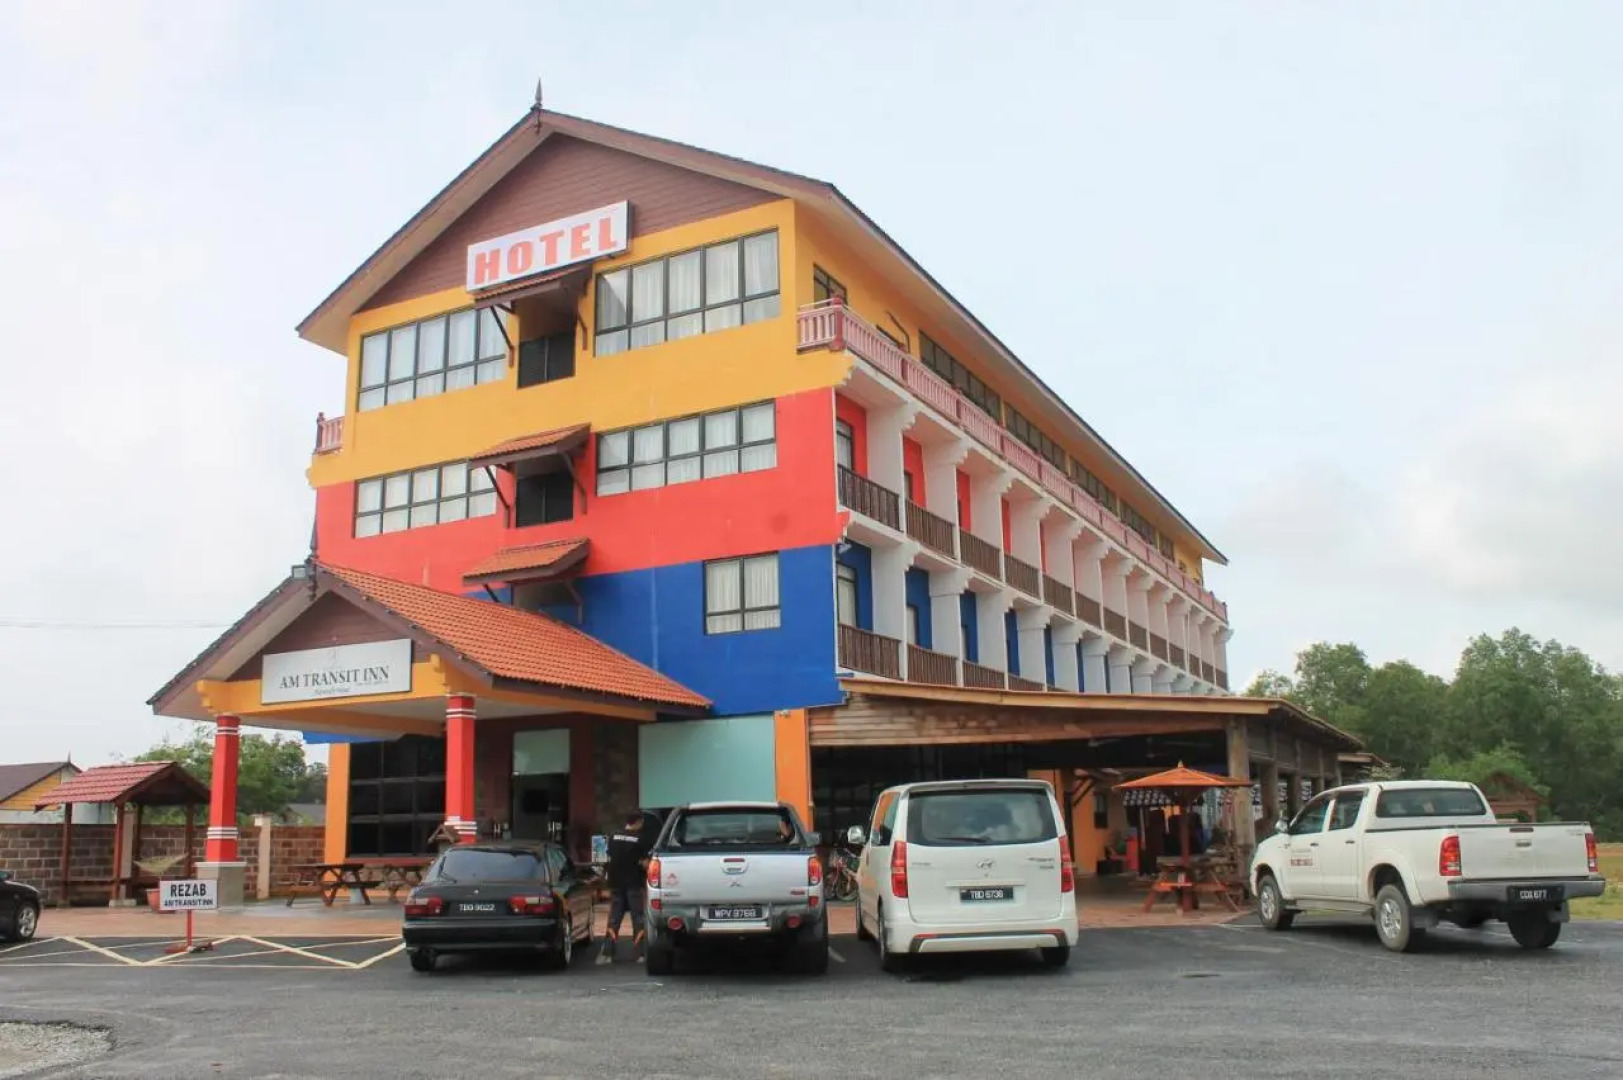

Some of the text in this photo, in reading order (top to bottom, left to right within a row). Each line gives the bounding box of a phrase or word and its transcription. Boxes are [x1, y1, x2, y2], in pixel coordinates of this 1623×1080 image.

[473, 217, 617, 285] HOTEL
[279, 665, 390, 689] AM TRANSIT INN
[170, 883, 207, 897] REZAB
[714, 908, 731, 918] WPV
